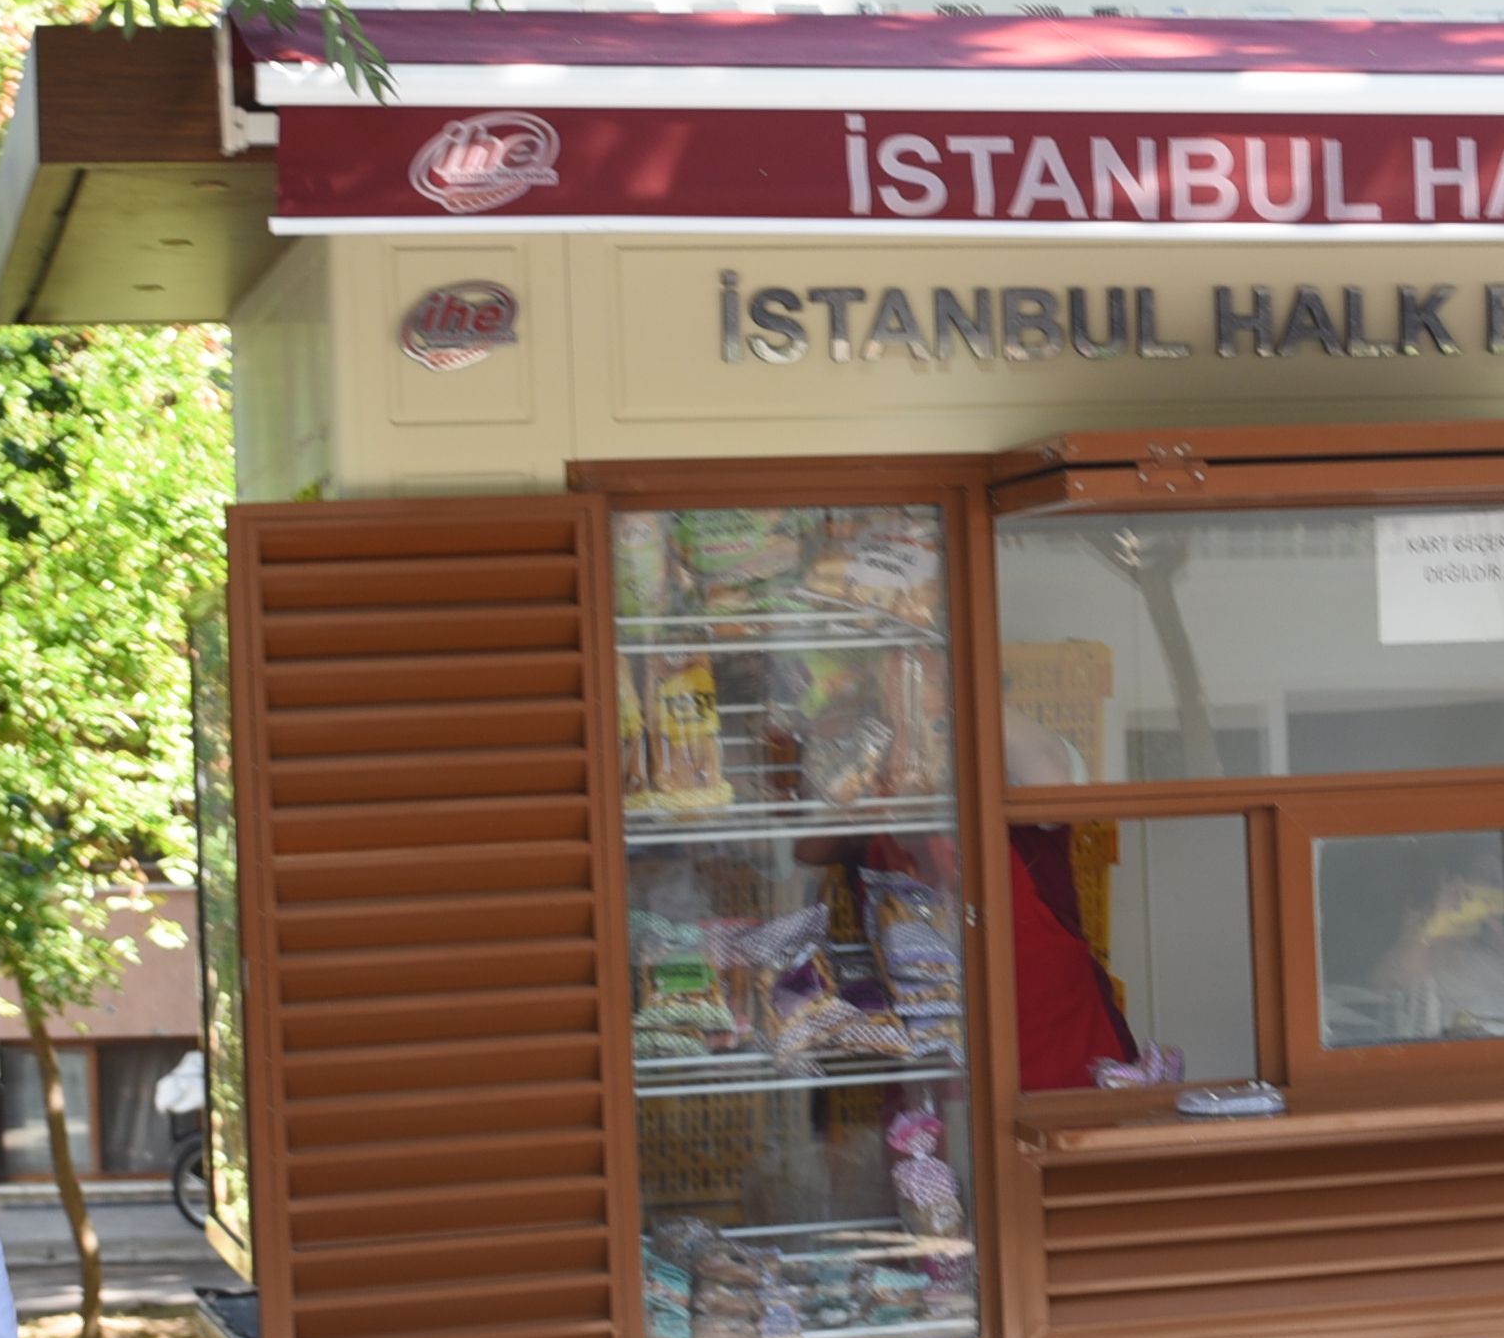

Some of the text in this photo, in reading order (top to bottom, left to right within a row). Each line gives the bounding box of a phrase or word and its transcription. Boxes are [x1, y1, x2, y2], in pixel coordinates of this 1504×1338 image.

[844, 113, 1383, 222] İSTANBUL
[419, 291, 503, 333] ihe
[718, 269, 1191, 364] İSTANBUL
[1212, 283, 1463, 360] HALK
[1405, 534, 1446, 555] KART
